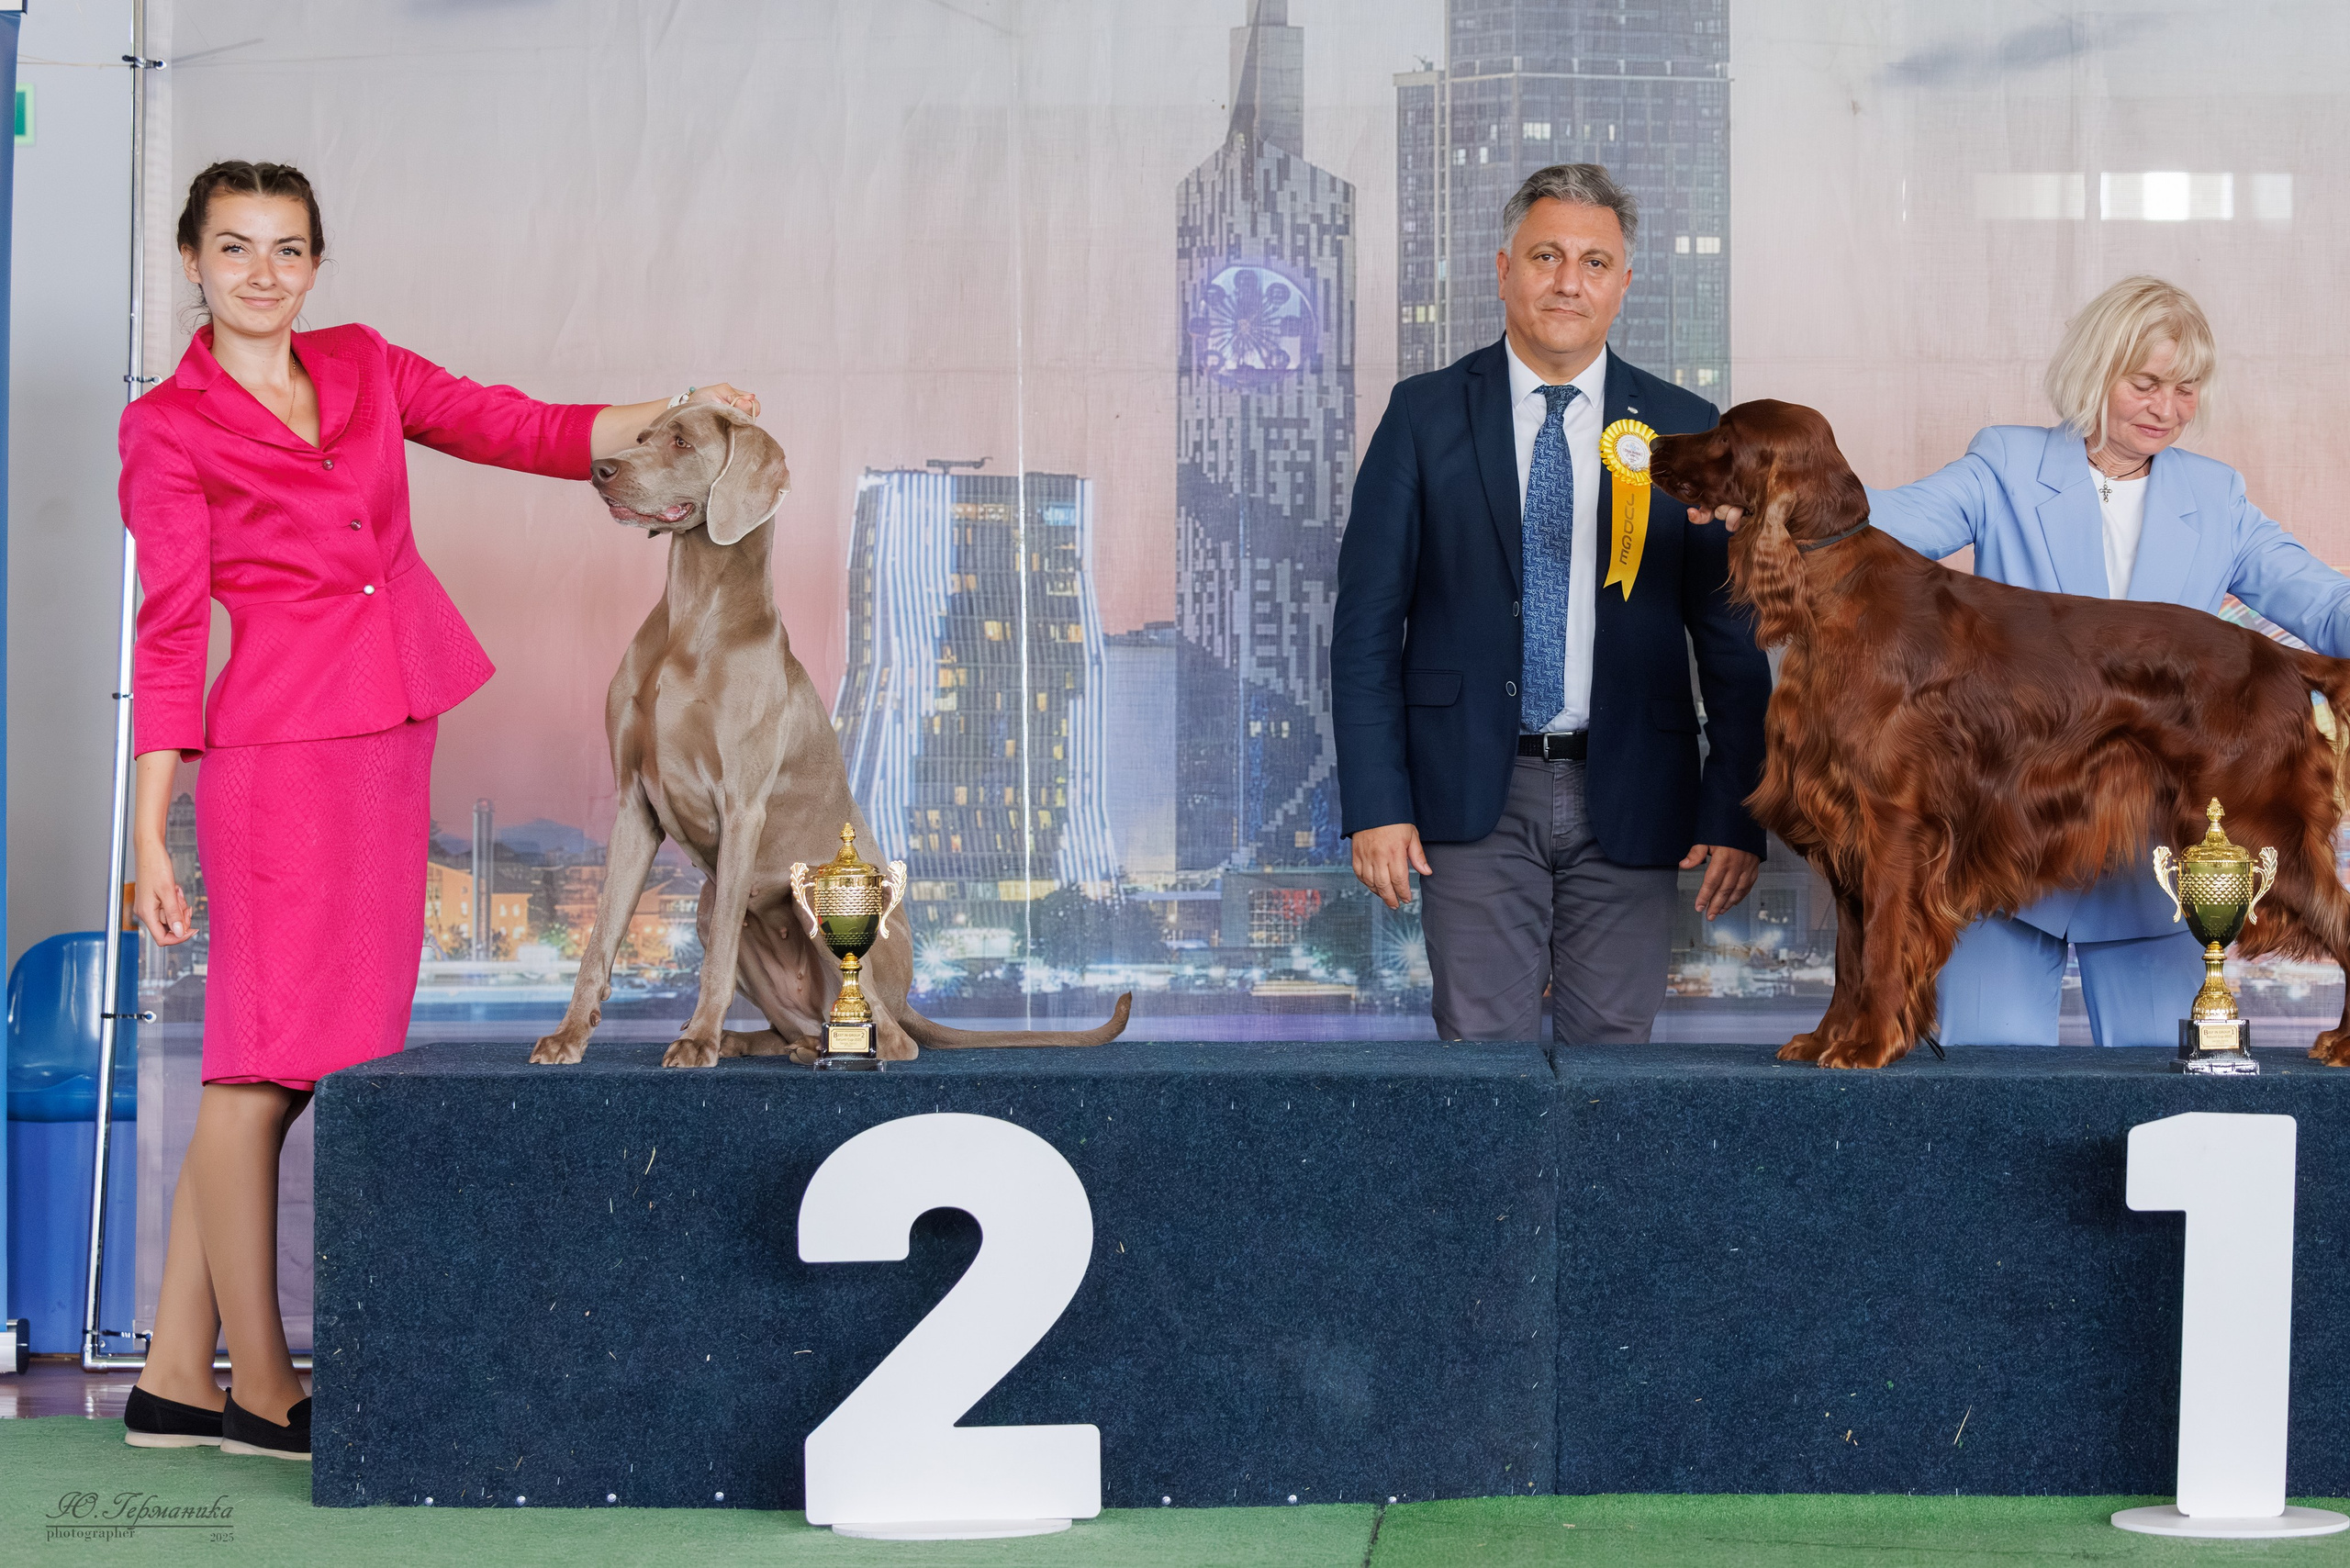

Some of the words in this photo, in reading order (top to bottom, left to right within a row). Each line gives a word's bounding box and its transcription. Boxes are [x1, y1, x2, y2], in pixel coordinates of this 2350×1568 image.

[1619, 493, 1635, 566] JUDGE
[799, 1113, 1101, 1525] 2
[2126, 1112, 2297, 1517] 1
